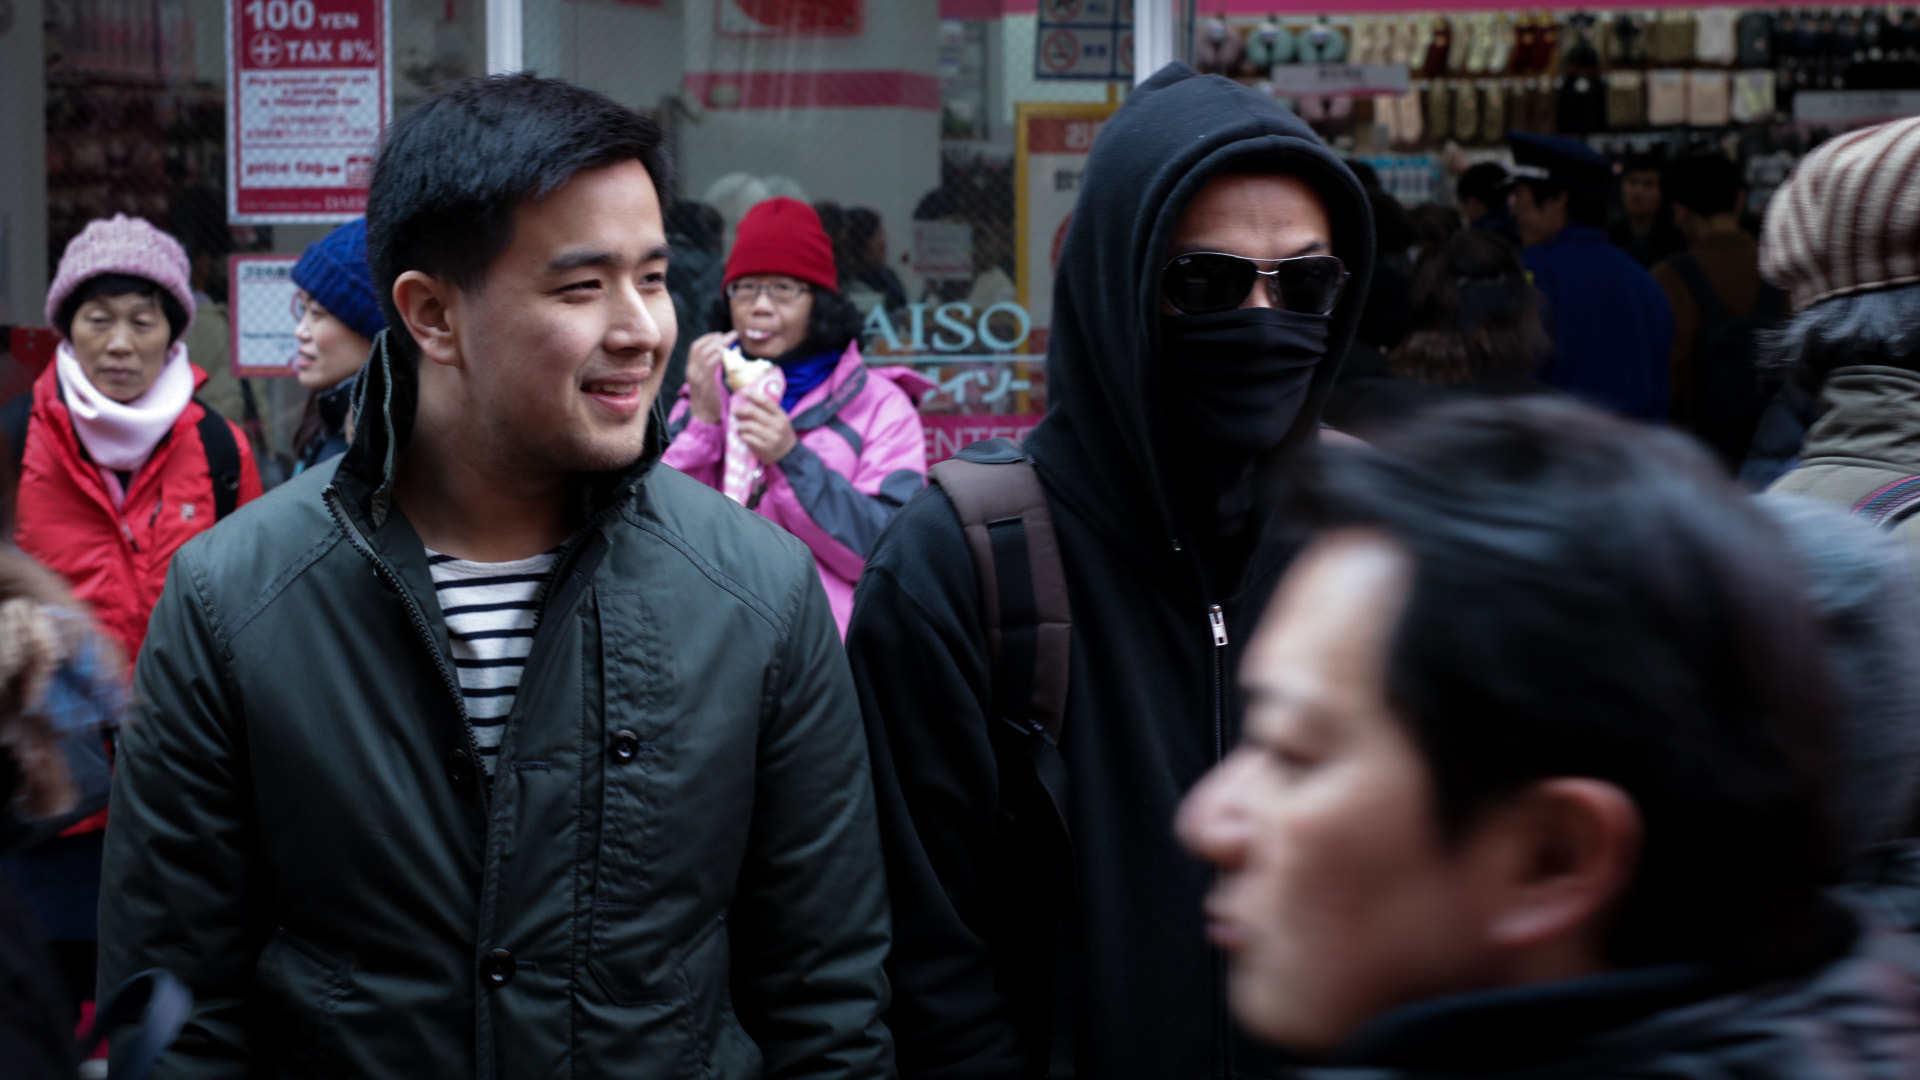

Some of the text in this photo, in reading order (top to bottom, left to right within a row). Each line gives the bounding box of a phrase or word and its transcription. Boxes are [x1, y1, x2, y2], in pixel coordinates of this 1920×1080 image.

[246, 0, 359, 30] 100 YEN
[287, 39, 376, 62] TAX 8%
[247, 160, 325, 178] price tag
[920, 367, 1032, 404] イソー
